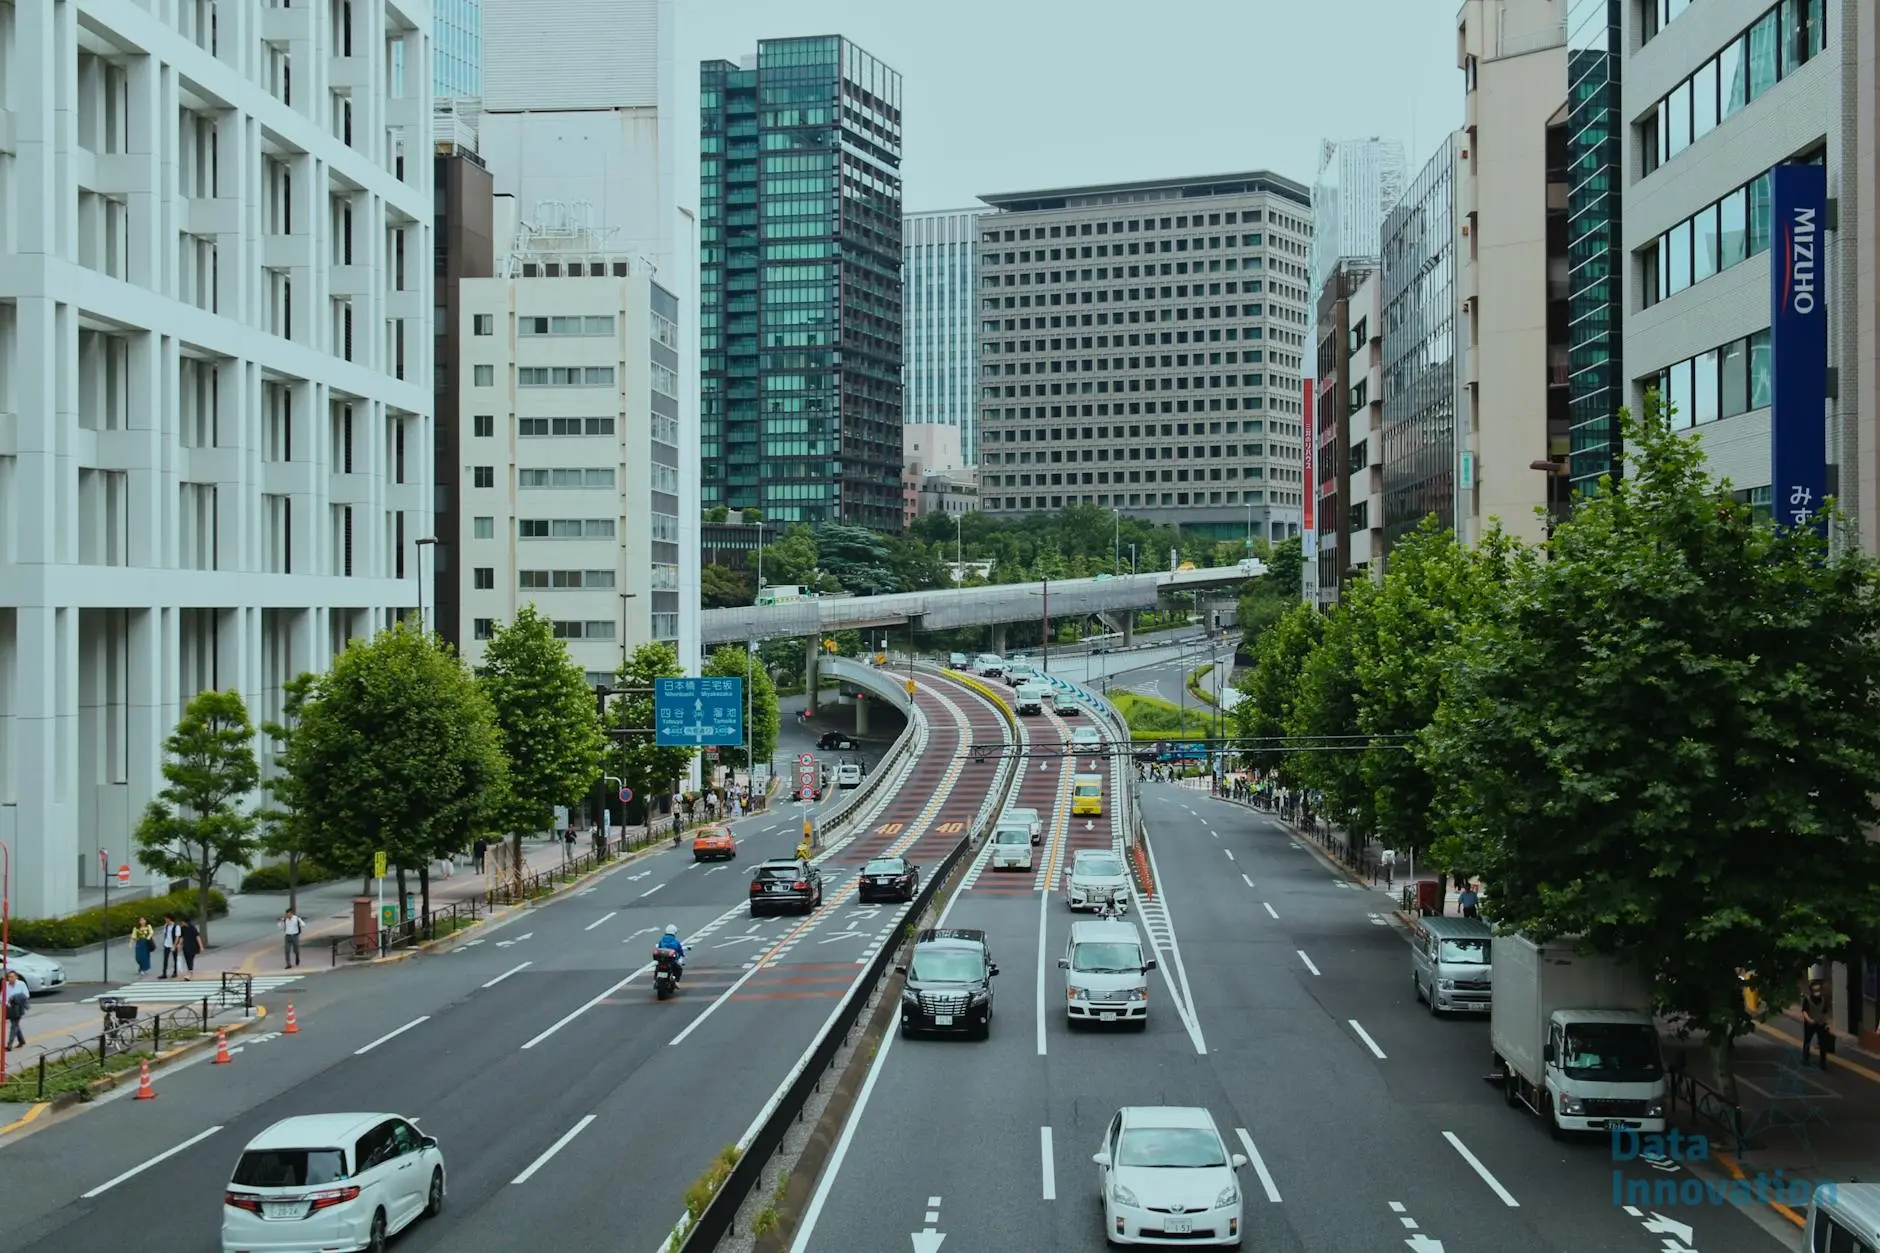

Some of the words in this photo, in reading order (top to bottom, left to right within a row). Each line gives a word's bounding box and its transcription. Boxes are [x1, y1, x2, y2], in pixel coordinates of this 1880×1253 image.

[1793, 207, 1816, 315] MIZUHO
[1304, 423, 1312, 470] 三井のリハウス
[664, 681, 695, 690] 日本橋
[701, 681, 732, 690] 三宅坂
[660, 708, 684, 718] 四谷
[873, 823, 903, 835] 40
[935, 822, 965, 833] 40
